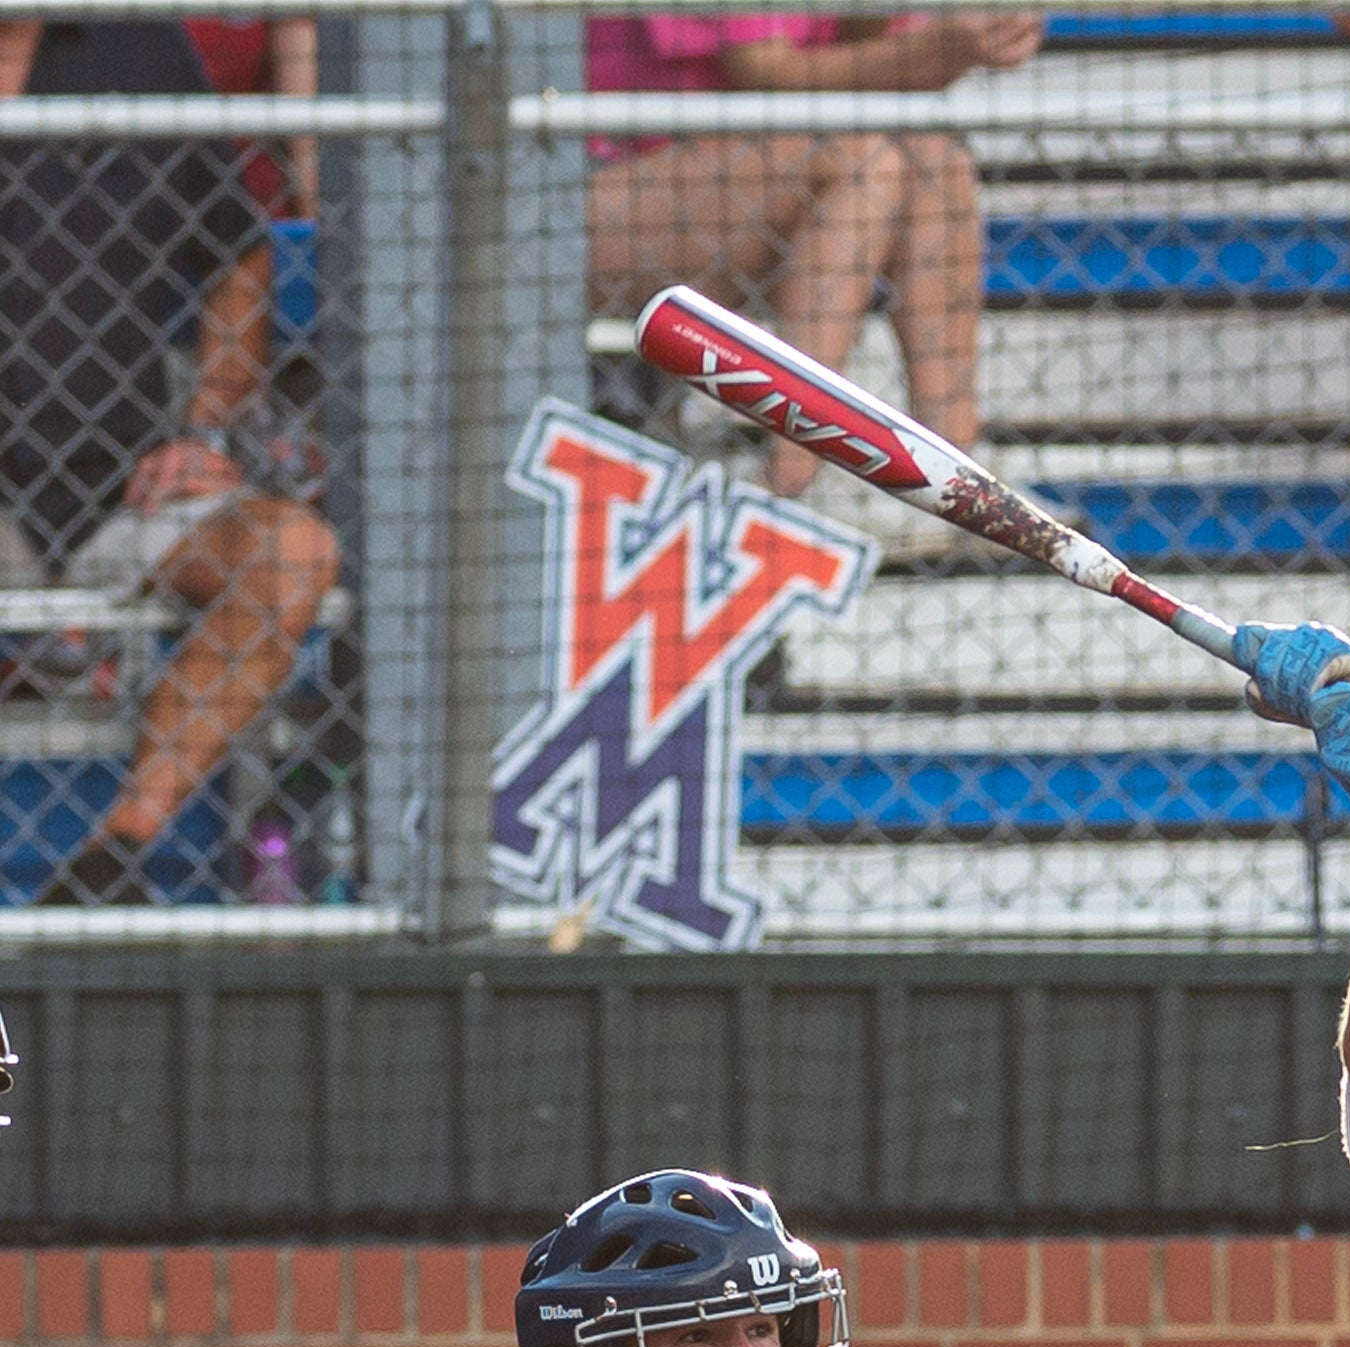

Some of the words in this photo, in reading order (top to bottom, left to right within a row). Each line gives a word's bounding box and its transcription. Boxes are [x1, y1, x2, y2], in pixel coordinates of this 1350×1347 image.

[670, 321, 743, 367] CONNECT
[746, 1253, 781, 1287] W
[539, 1304, 583, 1321] Wilson
